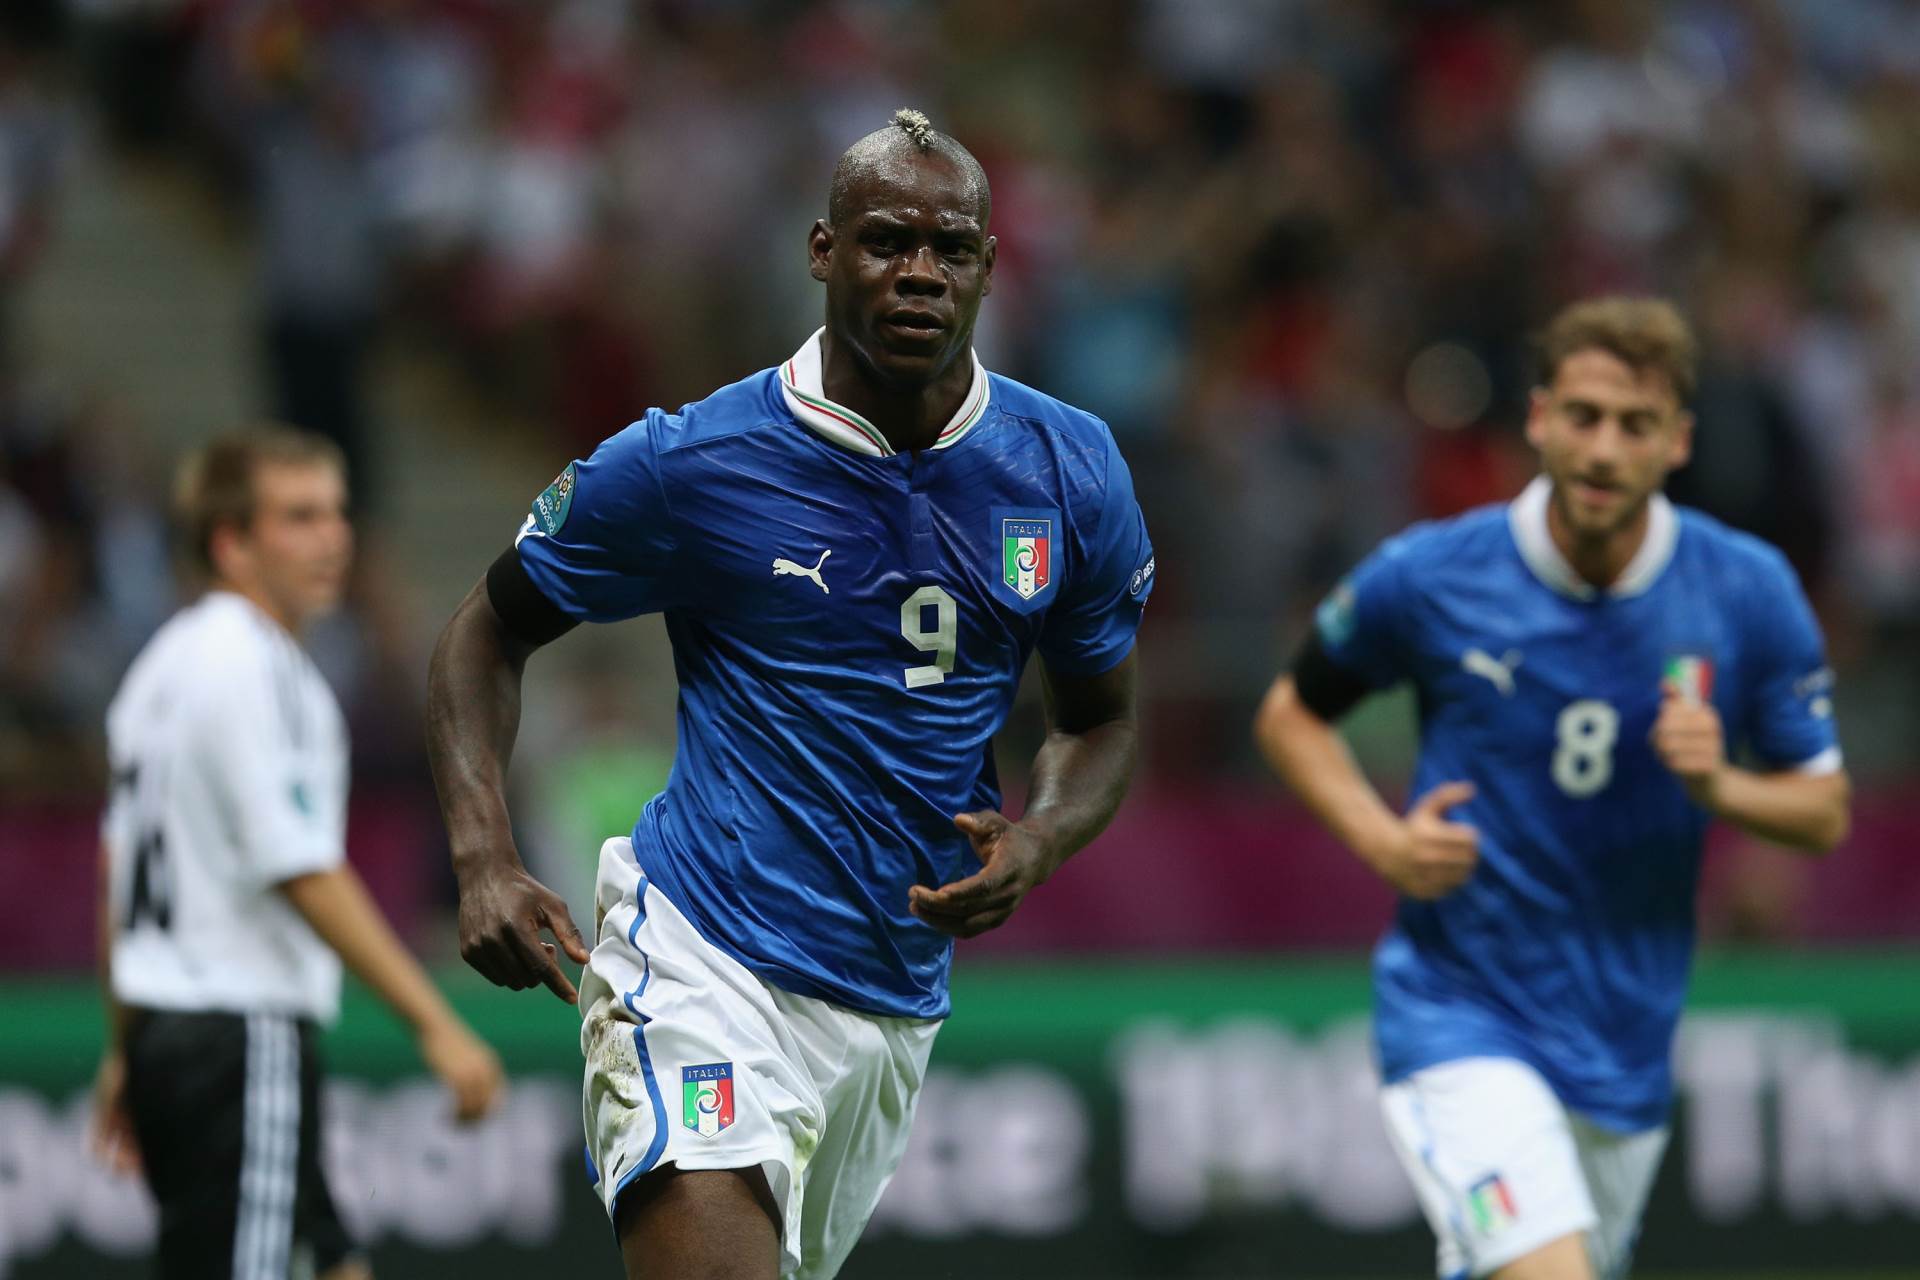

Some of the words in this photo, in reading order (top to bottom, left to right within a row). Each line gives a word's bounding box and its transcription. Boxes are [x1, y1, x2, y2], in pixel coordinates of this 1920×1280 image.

[1009, 525, 1043, 535] ITALIA
[1143, 556, 1155, 580] RES
[901, 585, 958, 689] 9
[1550, 699, 1620, 798] 8
[688, 1067, 727, 1079] ITALIA
